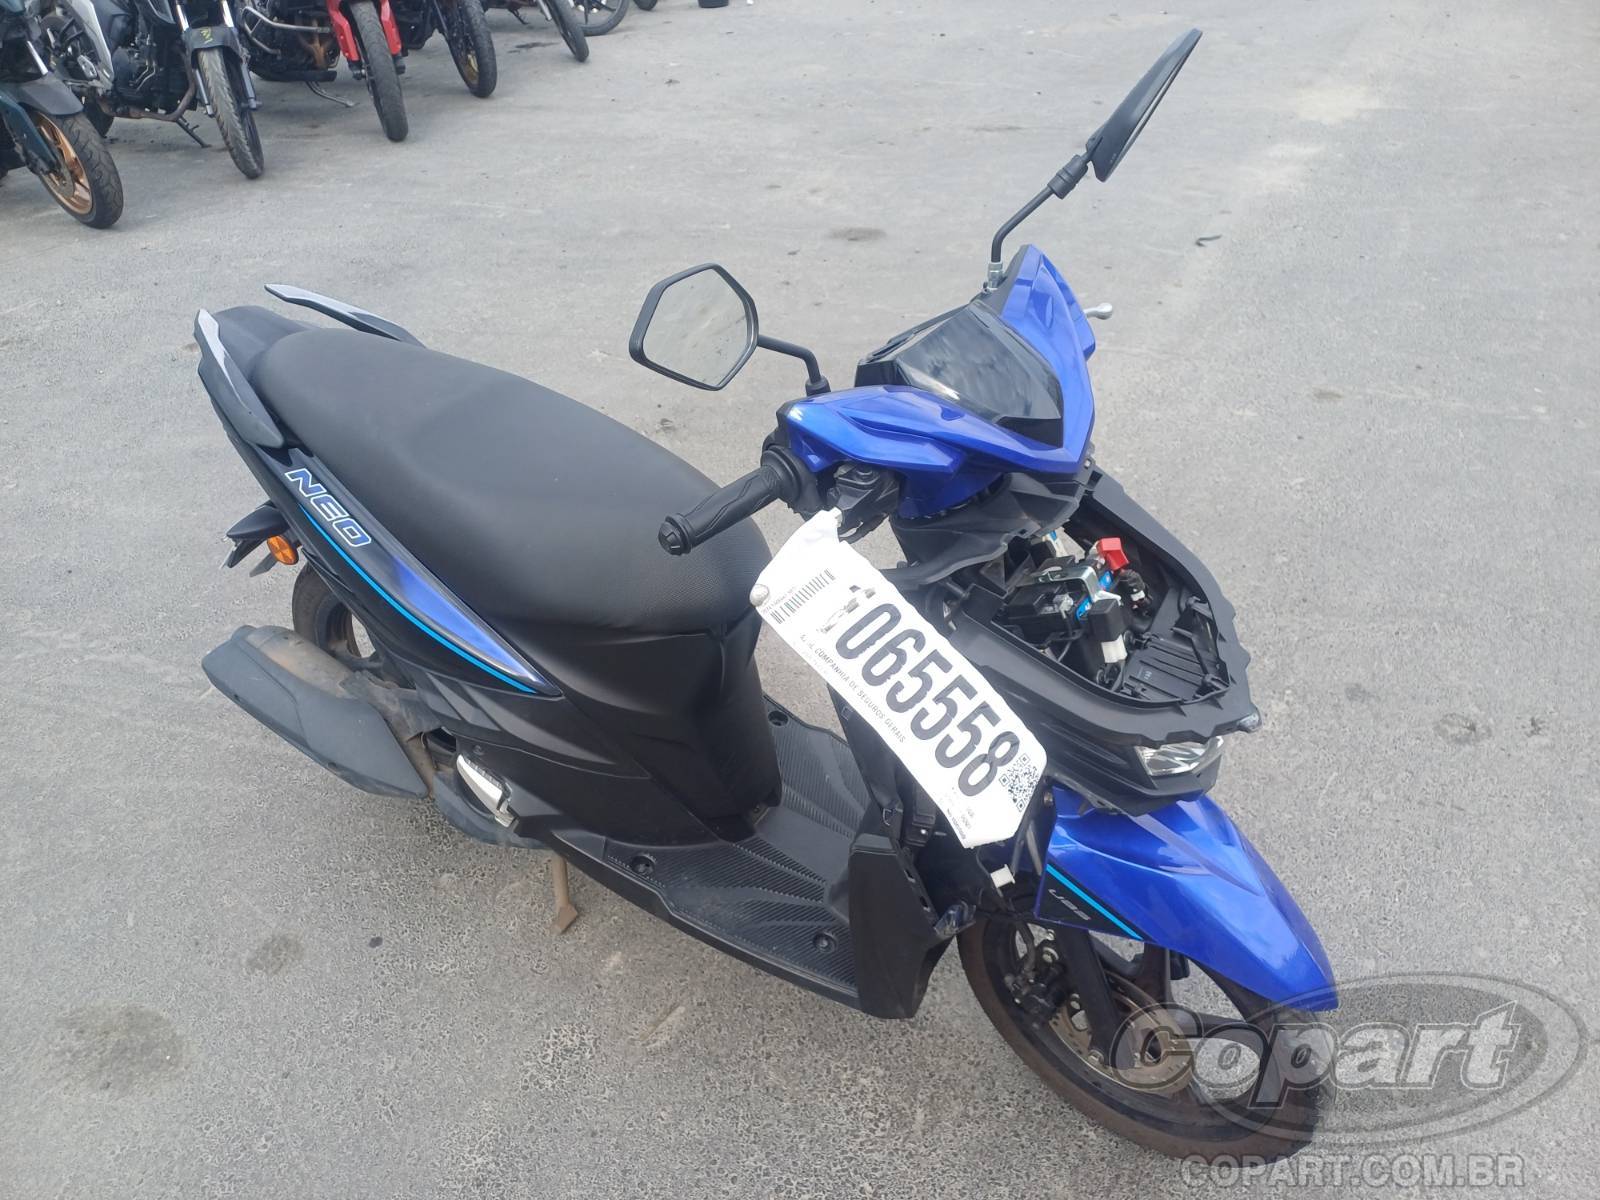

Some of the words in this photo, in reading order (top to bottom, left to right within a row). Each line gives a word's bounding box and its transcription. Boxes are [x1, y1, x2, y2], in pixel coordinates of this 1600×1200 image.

[285, 468, 372, 547] NEO
[857, 690, 886, 719] SEGUROS
[885, 718, 906, 743] GERAIS
